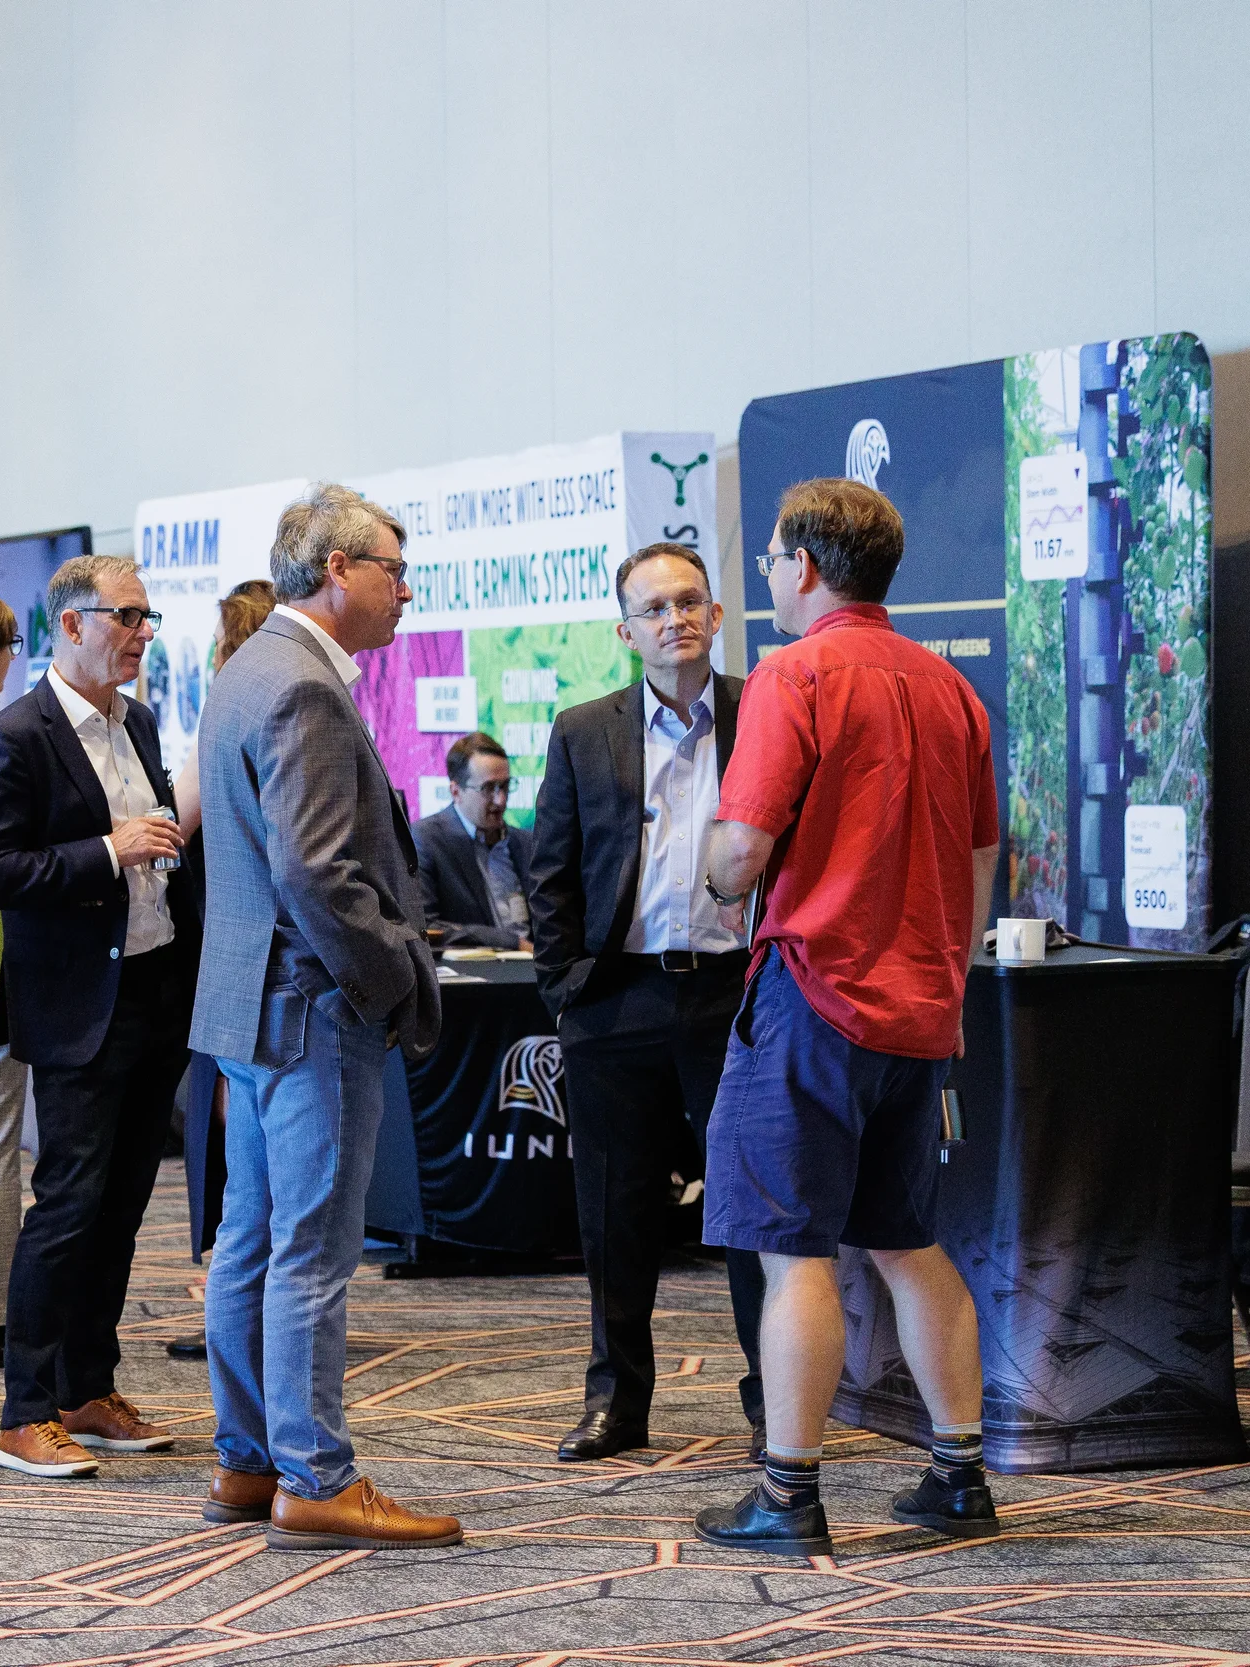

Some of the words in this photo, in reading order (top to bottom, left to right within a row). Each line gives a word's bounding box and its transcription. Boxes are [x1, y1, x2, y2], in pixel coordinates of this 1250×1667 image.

[446, 491, 477, 531] GROW
[481, 487, 511, 528] MORE
[514, 480, 545, 523] WITH
[549, 477, 574, 518] LESS
[578, 468, 616, 515] SPACE
[143, 519, 220, 569] DRAMM
[1034, 539, 1062, 560] 11.67
[408, 560, 469, 613] VERTICAL
[474, 553, 538, 609] FARMING
[543, 544, 610, 602] SYSTEMS
[1134, 889, 1167, 909] 9500
